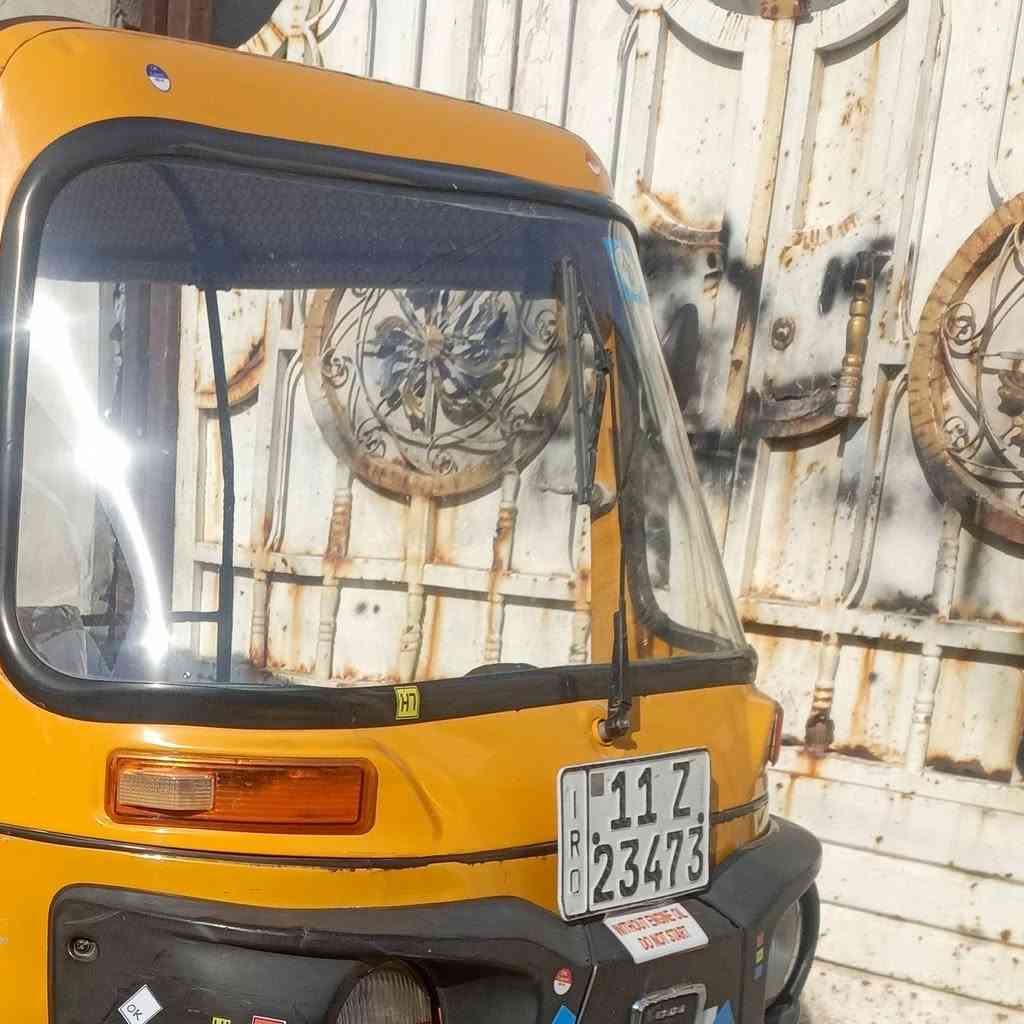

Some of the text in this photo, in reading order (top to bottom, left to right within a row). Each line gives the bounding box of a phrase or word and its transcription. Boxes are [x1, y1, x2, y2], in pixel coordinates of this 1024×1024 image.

[611, 761, 691, 830] 11 Z
[593, 826, 704, 903] 23473
[126, 1003, 144, 1020] OK
